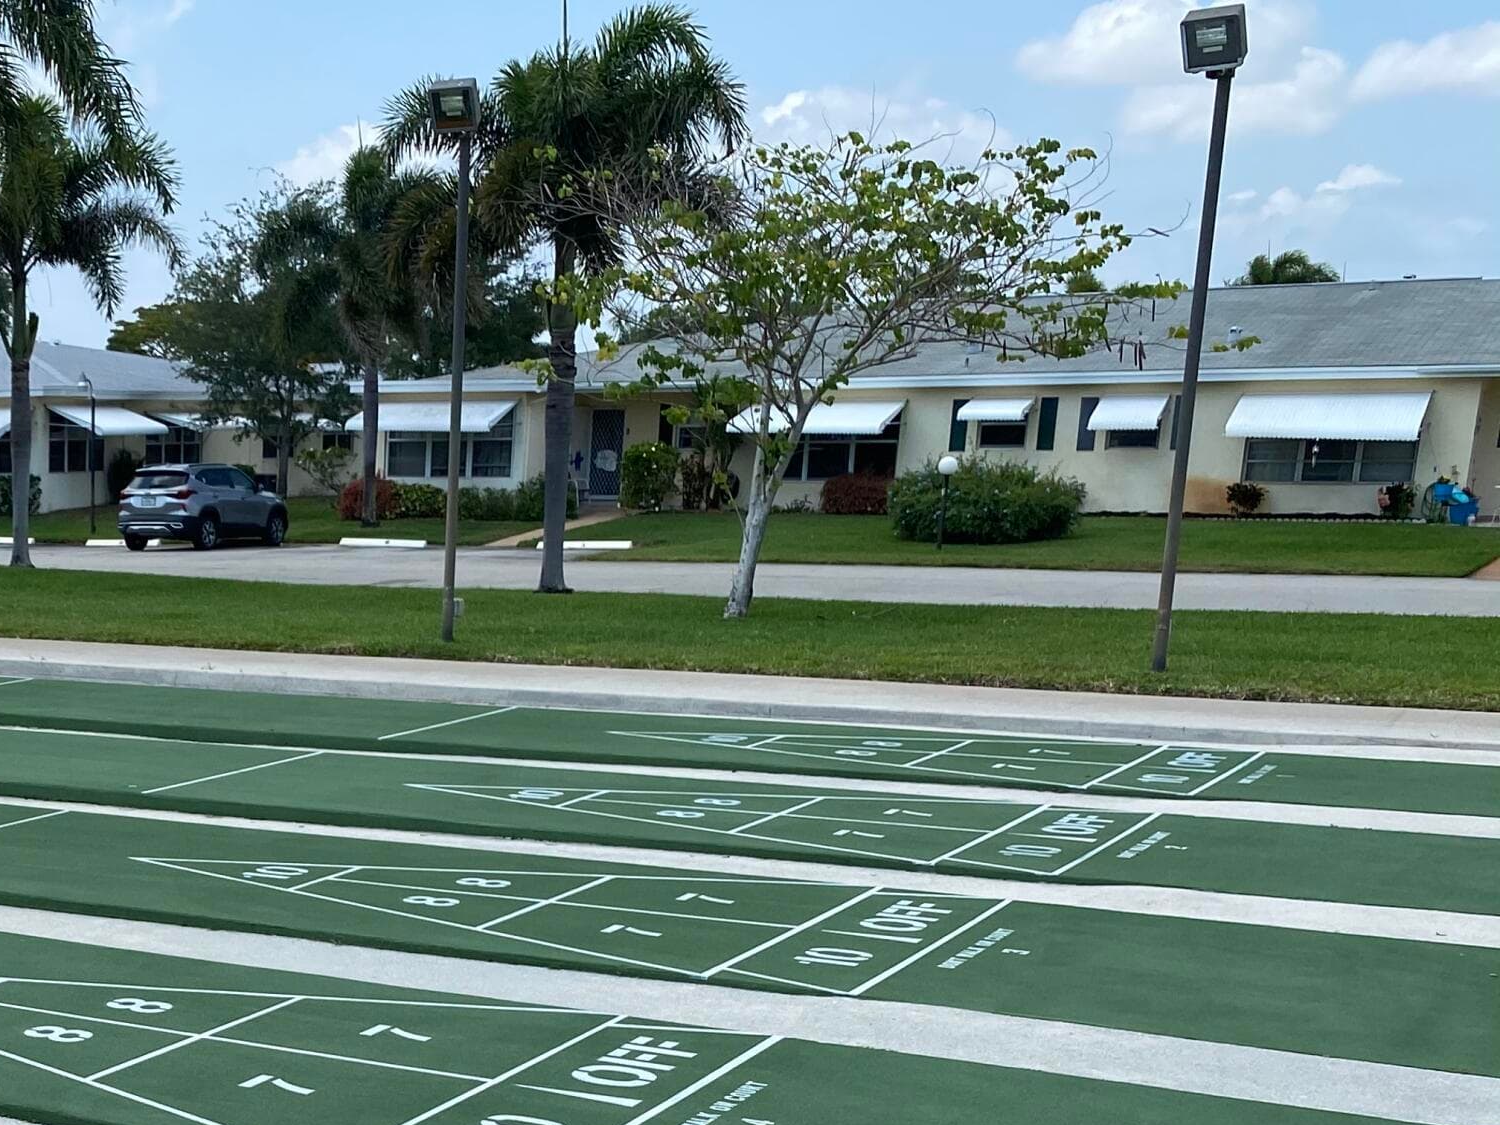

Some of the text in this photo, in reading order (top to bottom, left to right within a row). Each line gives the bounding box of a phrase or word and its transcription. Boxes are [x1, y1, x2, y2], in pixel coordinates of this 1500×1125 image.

[1166, 751, 1227, 768] OFF
[693, 798, 742, 806] 8
[655, 810, 706, 819] 8
[883, 808, 933, 817] 7
[832, 829, 885, 839] 7
[998, 813, 1115, 858] 10 OFF
[242, 865, 309, 880] 10
[455, 877, 512, 888] 8
[402, 895, 461, 907] 8
[675, 892, 735, 905] 7
[600, 924, 663, 937] 7
[793, 899, 953, 967] 10 OFF
[106, 997, 173, 1014] 8
[23, 1025, 94, 1043] 8
[359, 1024, 432, 1042] 7
[571, 1035, 698, 1088] OFF
[237, 1074, 316, 1095] 7
